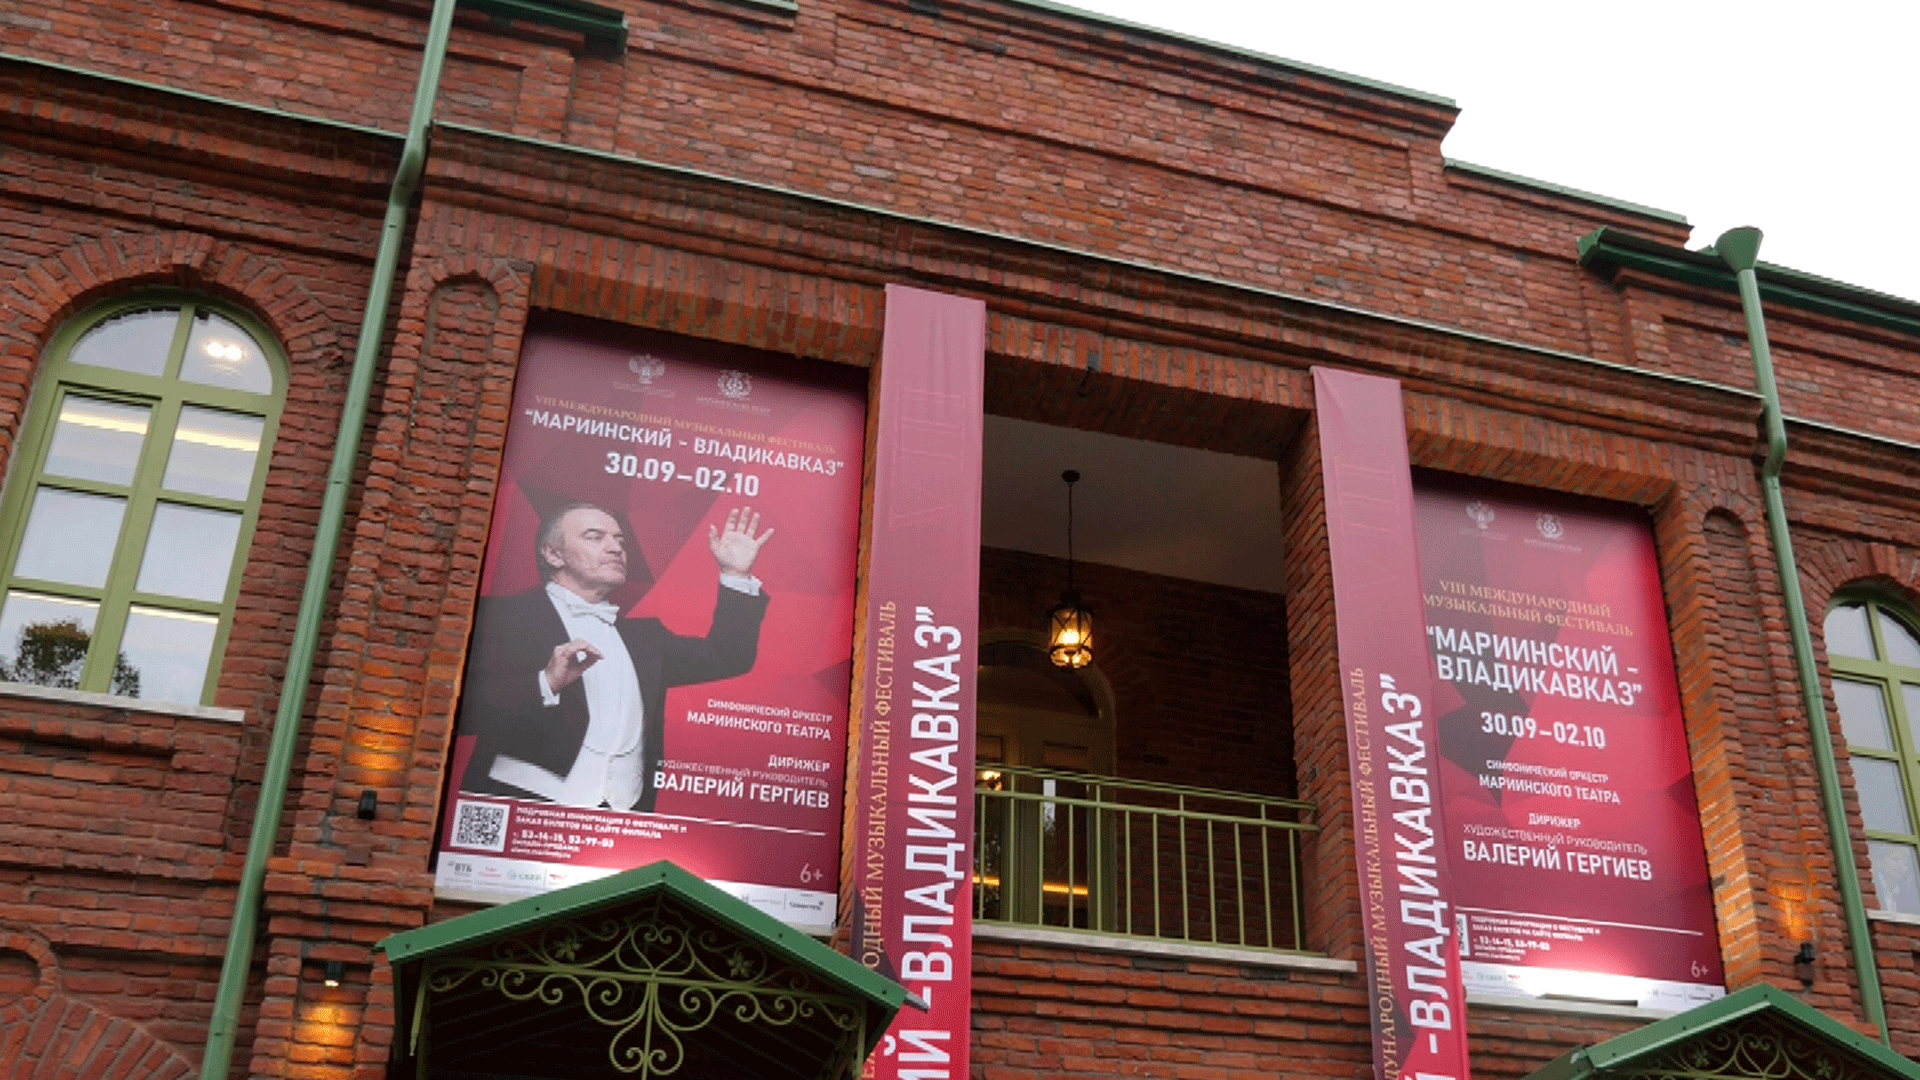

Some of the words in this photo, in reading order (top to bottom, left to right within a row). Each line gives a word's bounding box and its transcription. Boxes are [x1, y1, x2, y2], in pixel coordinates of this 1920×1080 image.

[557, 400, 671, 426] МЕЖДУНАРОДНЫЙ
[675, 419, 766, 443] МУЗЫКАЛЬНЫЙ
[767, 433, 836, 454] ФЕСТИВАЛЬ
[1440, 580, 1465, 595] VIII
[1470, 584, 1611, 618] МЕЖДУНАРОДНЫЙ
[1544, 613, 1633, 637] ФЕСТИВАЛЬ
[875, 601, 896, 716] ФЕСТИВАЛЬ
[687, 711, 782, 734] МАРИИНСКОГО
[786, 724, 832, 741] ТЕАТРА
[707, 699, 790, 718] СИМФОНИЧЕСКИЙ
[792, 710, 832, 723] ОРКЕСТР
[1350, 667, 1372, 776] ФЕСТИВАЛЬ
[657, 760, 750, 778] ХУДОЖЕСТВЕННЫЙ
[752, 770, 828, 788] РУКОВОДИТЕЛЬ
[768, 755, 830, 772] ДИРИЖЕР
[1486, 759, 1567, 778] СИМФОНИЧЕСКИЙ
[1569, 771, 1609, 783] ОРКЕСТР
[653, 771, 744, 798] ВАЛЕРИЙ
[750, 783, 830, 809] ГЕРГИЕВ
[866, 720, 891, 887] МУЗЫКАЛЬНЫЙ
[1479, 774, 1572, 797] МАРИИНСКОГО
[1575, 786, 1621, 804] ТЕАТРА
[1528, 813, 1581, 829] ДИРИЖЕР
[1463, 824, 1565, 845] ХУДОЖЕСТВЕННЫЙ
[1567, 835, 1648, 855] РУКОВОДИТЕЛЬ
[1356, 779, 1387, 932] МУЗЫКАЛЬНЫЙ
[1463, 840, 1561, 870] ВАЛЕРИЙ
[1566, 851, 1652, 881] ГЕРГИЕВ
[799, 863, 823, 883] 6+
[1691, 960, 1708, 977] 6+
